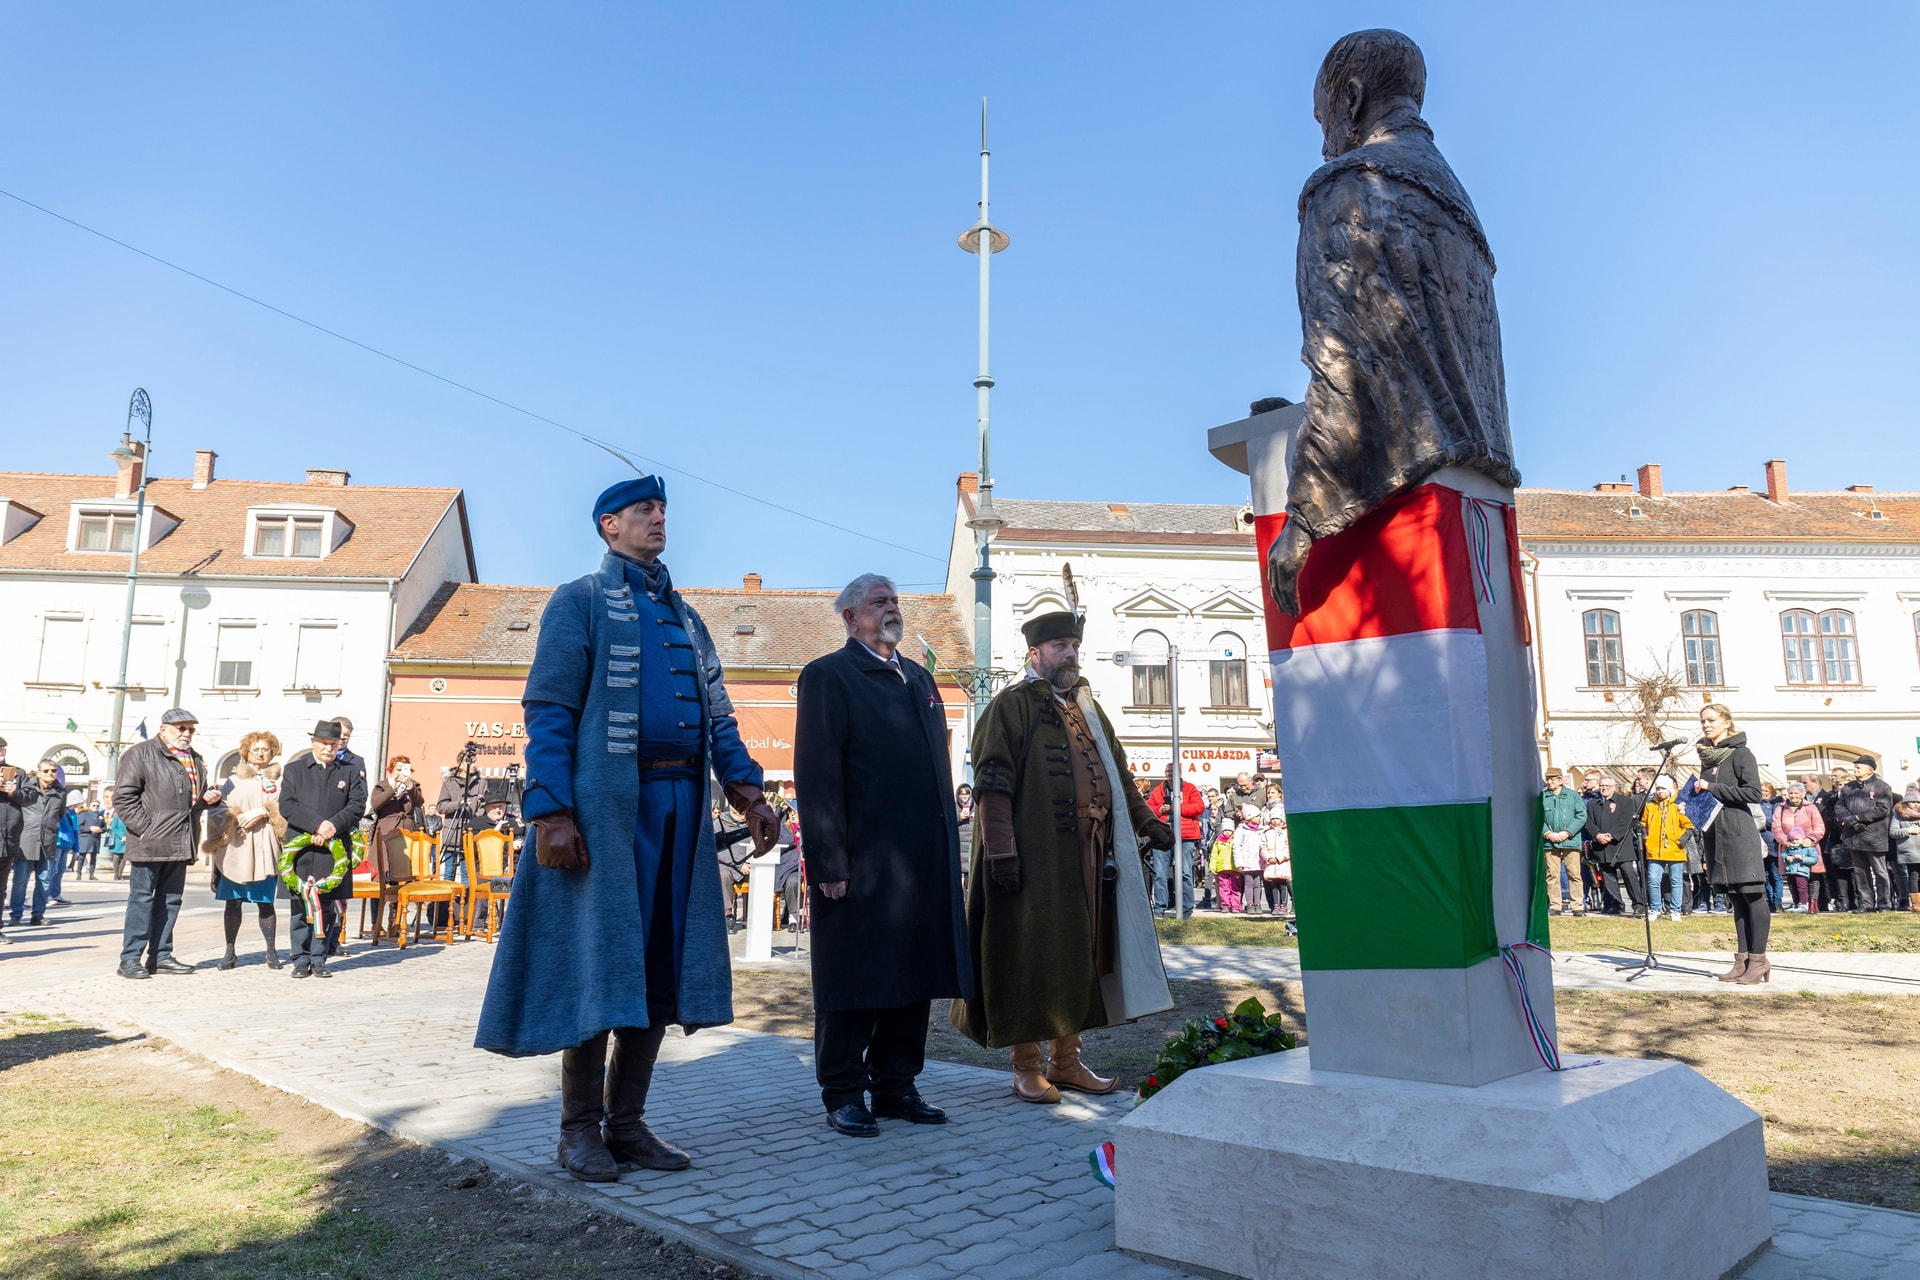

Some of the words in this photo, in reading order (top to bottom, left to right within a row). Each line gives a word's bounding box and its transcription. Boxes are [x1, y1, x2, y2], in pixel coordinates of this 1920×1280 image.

[465, 721, 530, 739] VAS-E
[744, 736, 770, 749] rbal
[1182, 746, 1251, 760] CUKRÁSZDA
